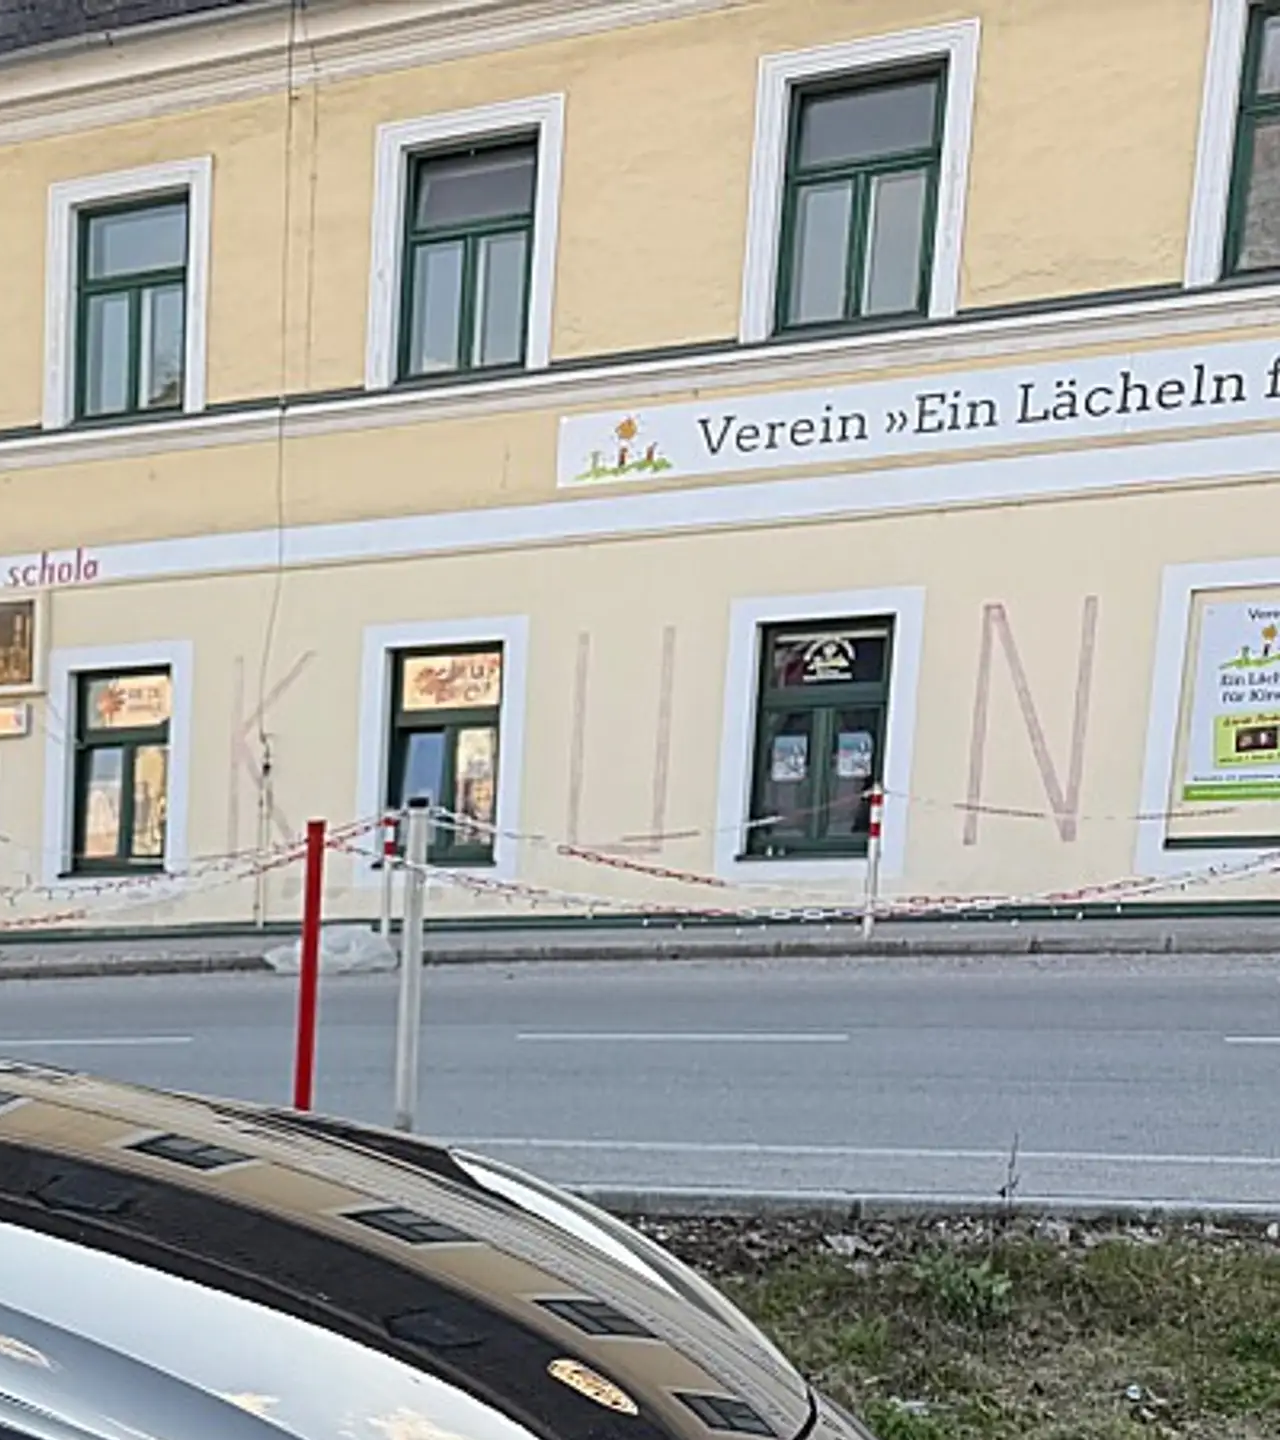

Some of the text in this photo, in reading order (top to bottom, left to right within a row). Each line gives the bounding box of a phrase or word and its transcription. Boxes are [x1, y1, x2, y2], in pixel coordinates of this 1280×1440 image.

[698, 405, 869, 456] Verein
[1016, 364, 1247, 422] Lächeln
[7, 547, 101, 588] schola
